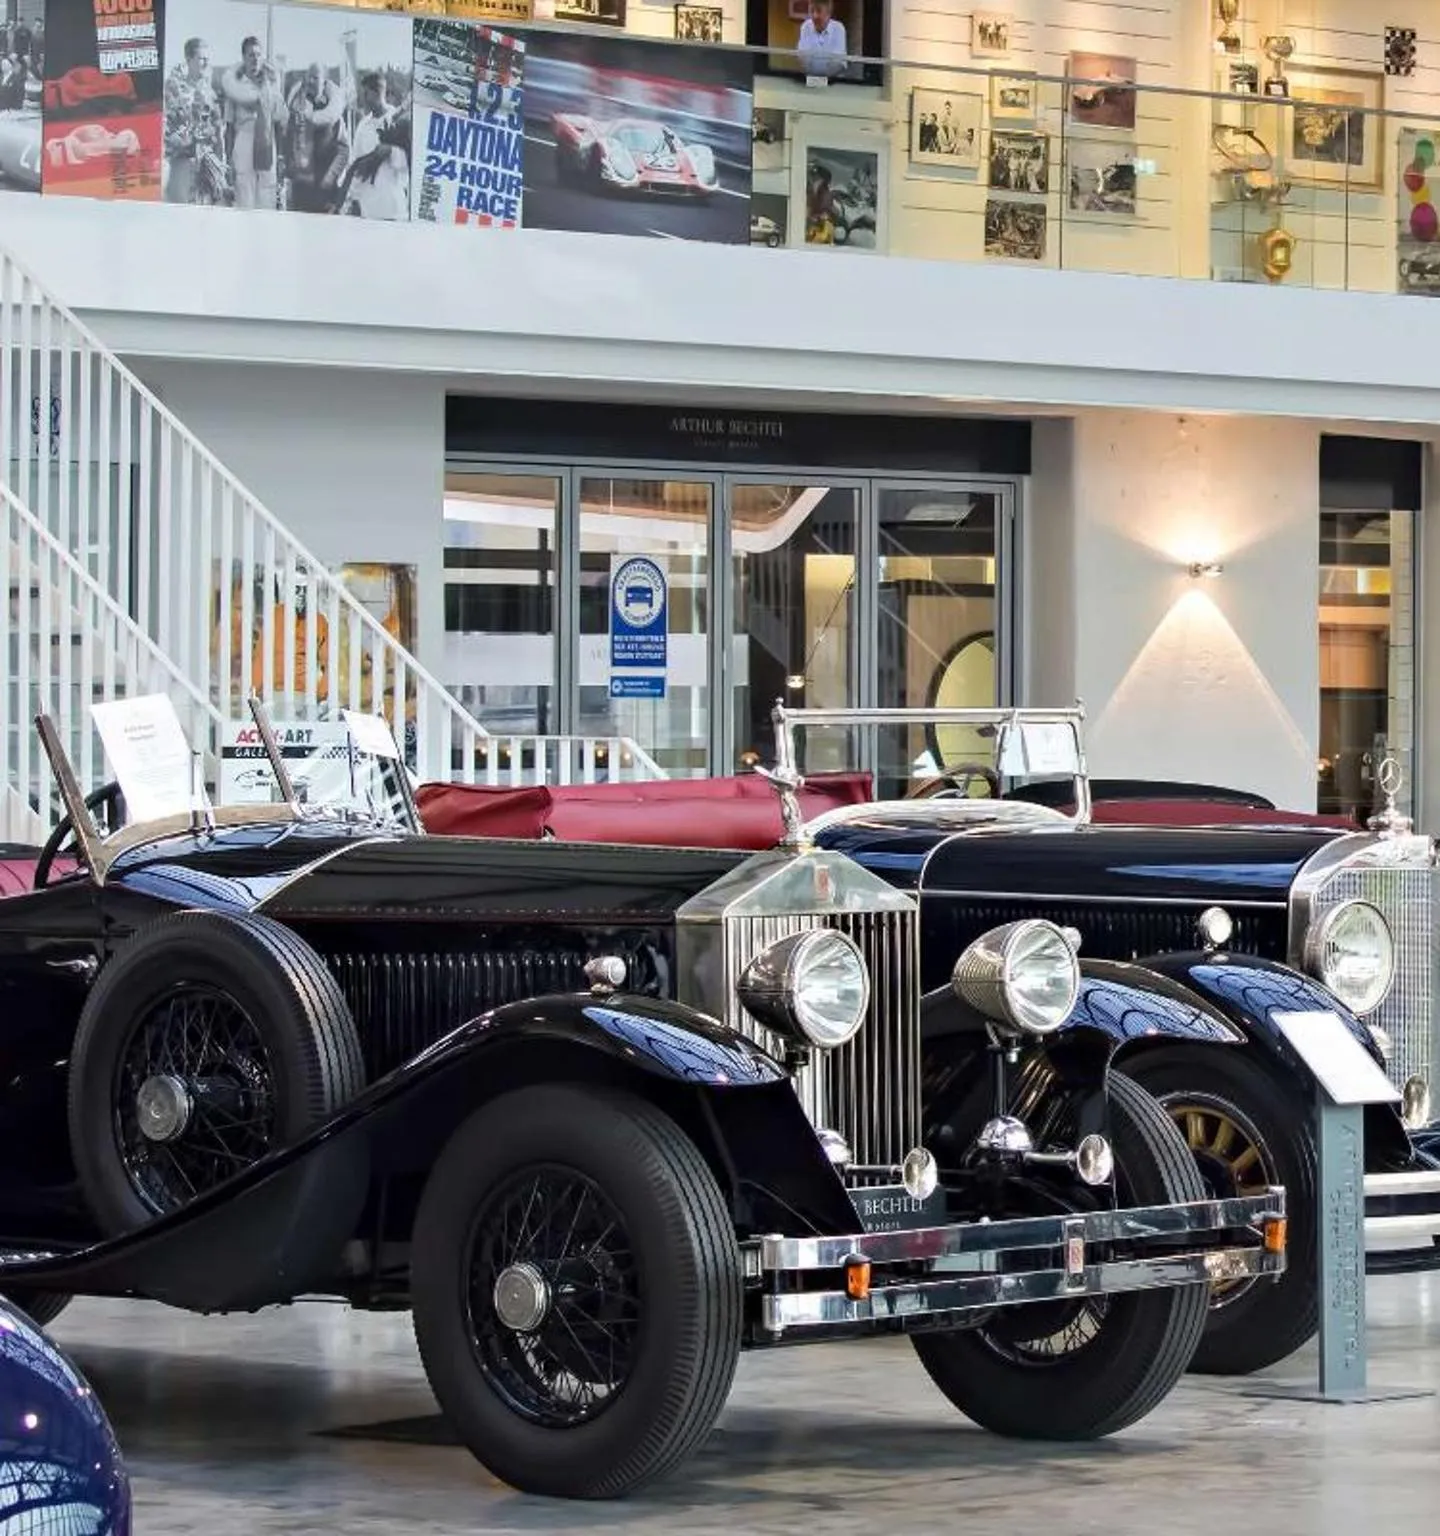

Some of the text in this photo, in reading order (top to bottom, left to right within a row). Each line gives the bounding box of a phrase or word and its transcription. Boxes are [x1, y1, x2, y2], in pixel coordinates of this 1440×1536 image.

[427, 110, 523, 173] DAYTONA
[424, 154, 523, 198] 24 HOUR
[456, 185, 518, 221] RACE
